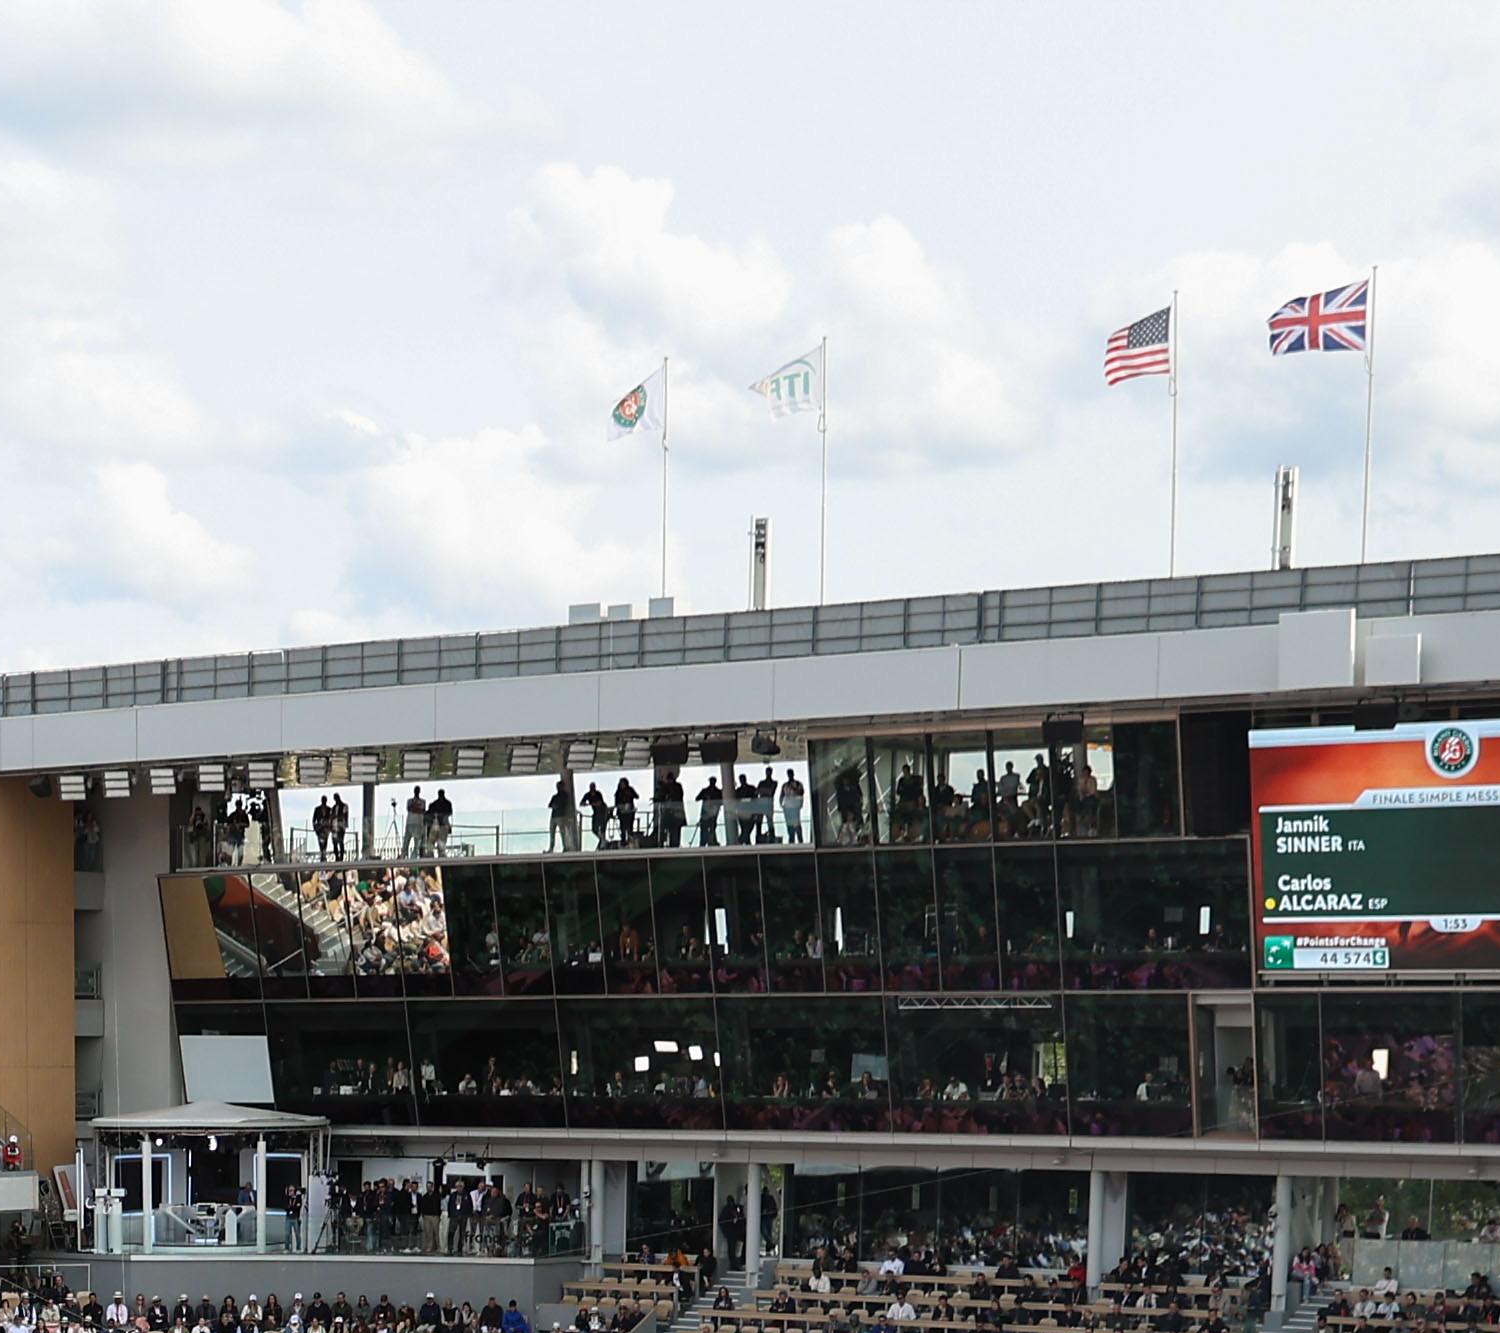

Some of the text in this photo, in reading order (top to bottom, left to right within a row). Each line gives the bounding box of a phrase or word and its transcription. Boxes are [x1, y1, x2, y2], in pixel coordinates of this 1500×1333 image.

[1372, 792, 1416, 805] FINALE
[1419, 790, 1464, 804] SIMPLE
[1276, 816, 1329, 835] Jannik
[1276, 836, 1365, 854] SINNER ITA
[1278, 874, 1331, 892] Carlos
[1278, 894, 1388, 913] ALCARAZ ESP
[1442, 917, 1468, 931] 1:53
[1296, 935, 1387, 948] #PointsForChange
[1319, 951, 1340, 966] 44
[1344, 950, 1371, 965] 574
